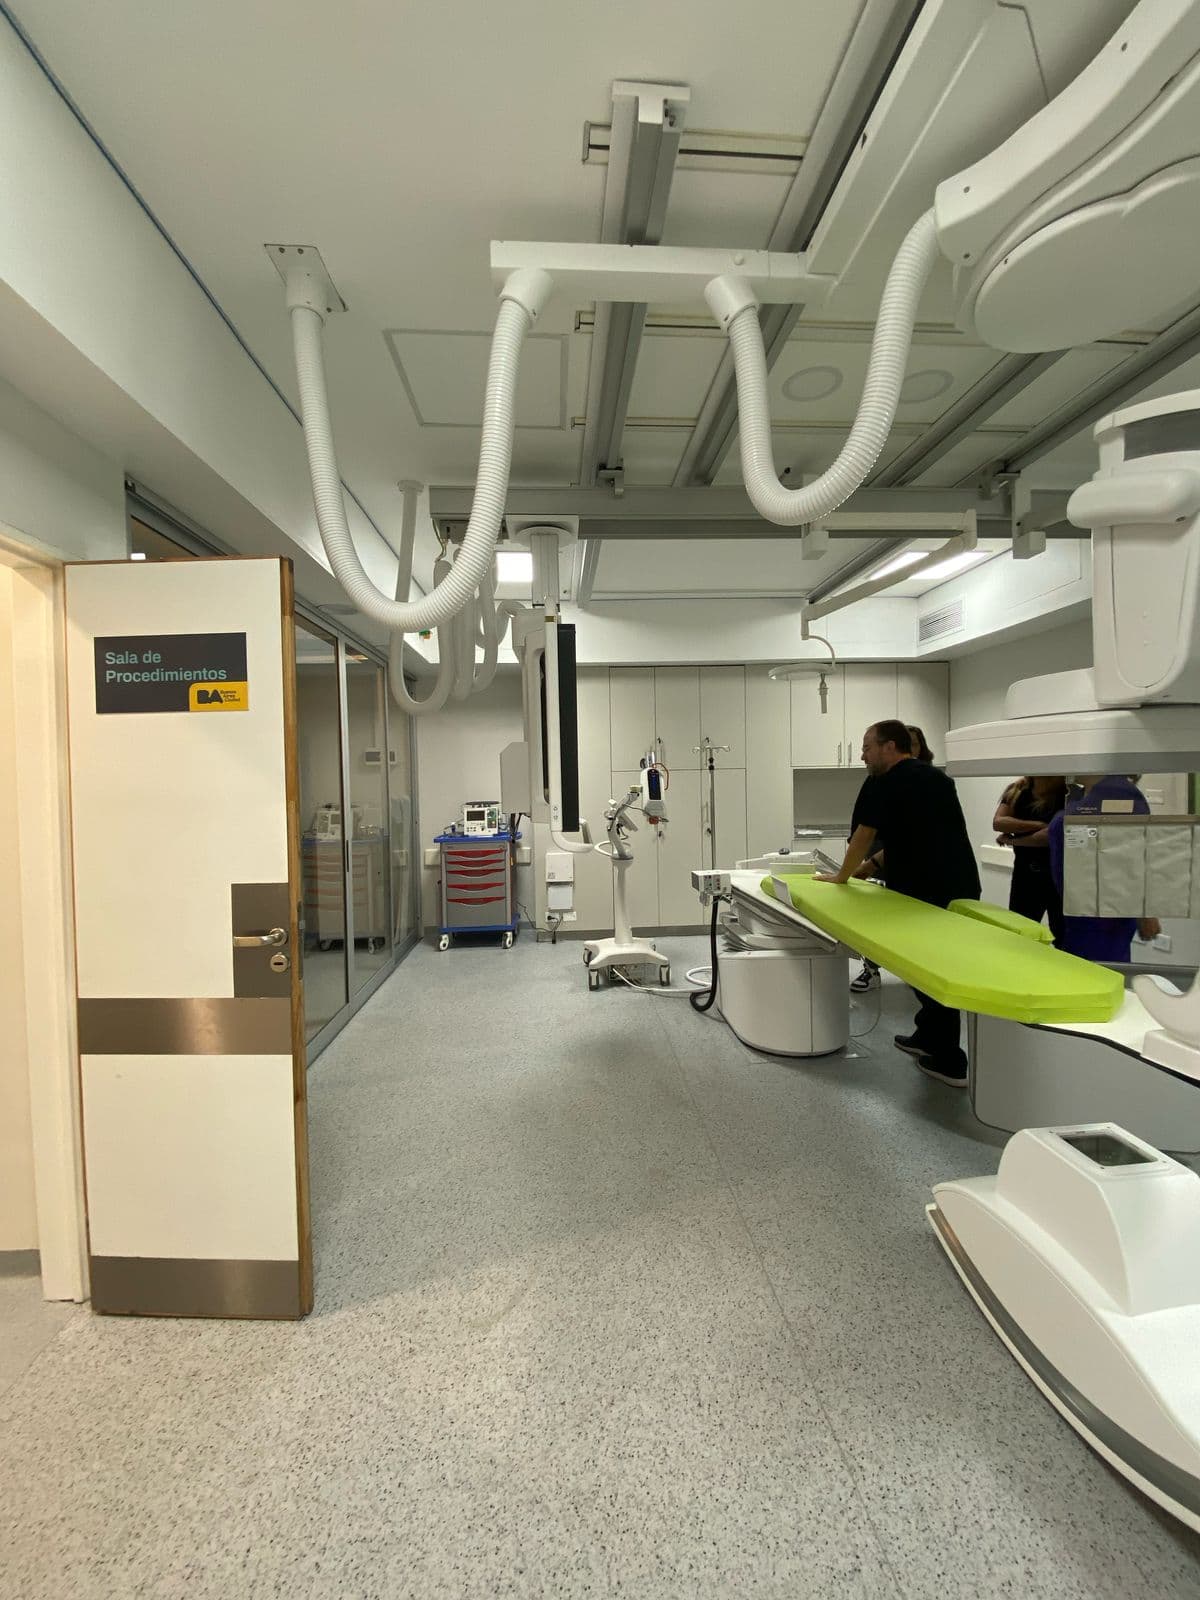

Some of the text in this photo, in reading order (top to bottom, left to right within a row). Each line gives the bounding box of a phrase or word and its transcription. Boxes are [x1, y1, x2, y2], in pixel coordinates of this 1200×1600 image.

[105, 650, 161, 665] Sala de
[106, 668, 228, 683] Procedimientos
[197, 689, 223, 704] BA
